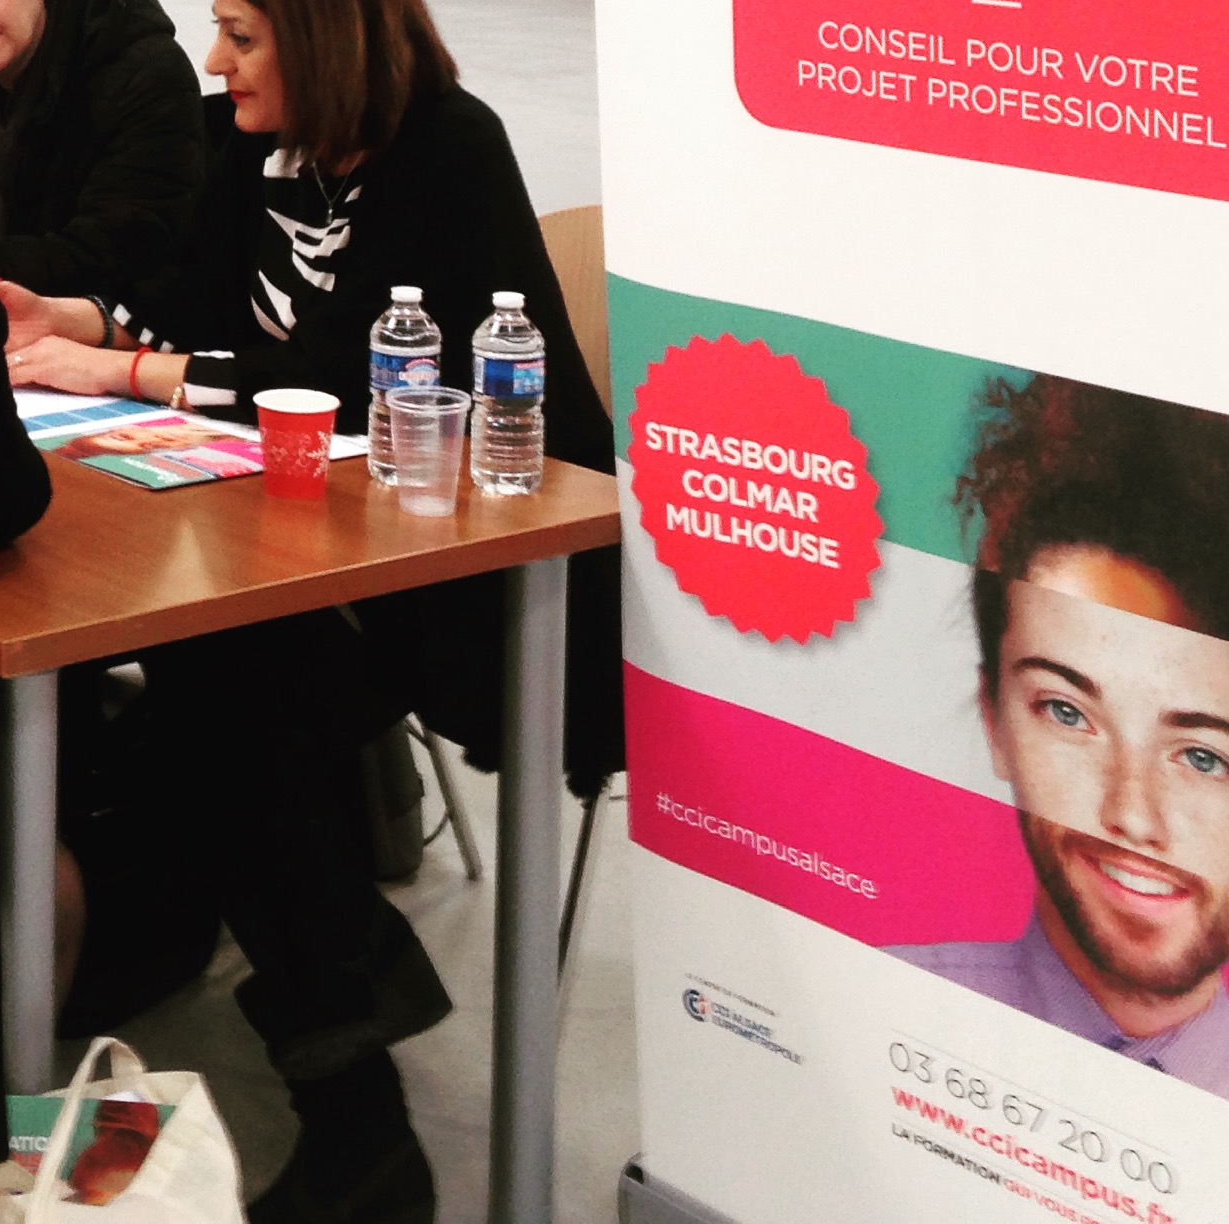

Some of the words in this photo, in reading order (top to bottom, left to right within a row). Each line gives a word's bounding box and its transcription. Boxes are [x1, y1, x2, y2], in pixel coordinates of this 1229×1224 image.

[818, 20, 956, 66] CONSEIL
[966, 39, 1064, 79] POUR
[1075, 51, 1199, 98] VOTRE
[797, 60, 917, 102] PROJET
[928, 78, 1228, 149] PROFESSIONNEL
[645, 421, 857, 491] STRASBOURG
[681, 469, 820, 523] COLMAR
[665, 502, 841, 569] MULHOUSE
[656, 791, 880, 899] #ccicampusalsace
[889, 1041, 933, 1084] 03
[944, 1067, 990, 1109] 68
[1002, 1093, 1046, 1132] 67
[1057, 1118, 1108, 1163] 20
[1119, 1147, 1174, 1194] 00
[892, 1122, 910, 1139] LA
[913, 1133, 1001, 1185] FORMATION
